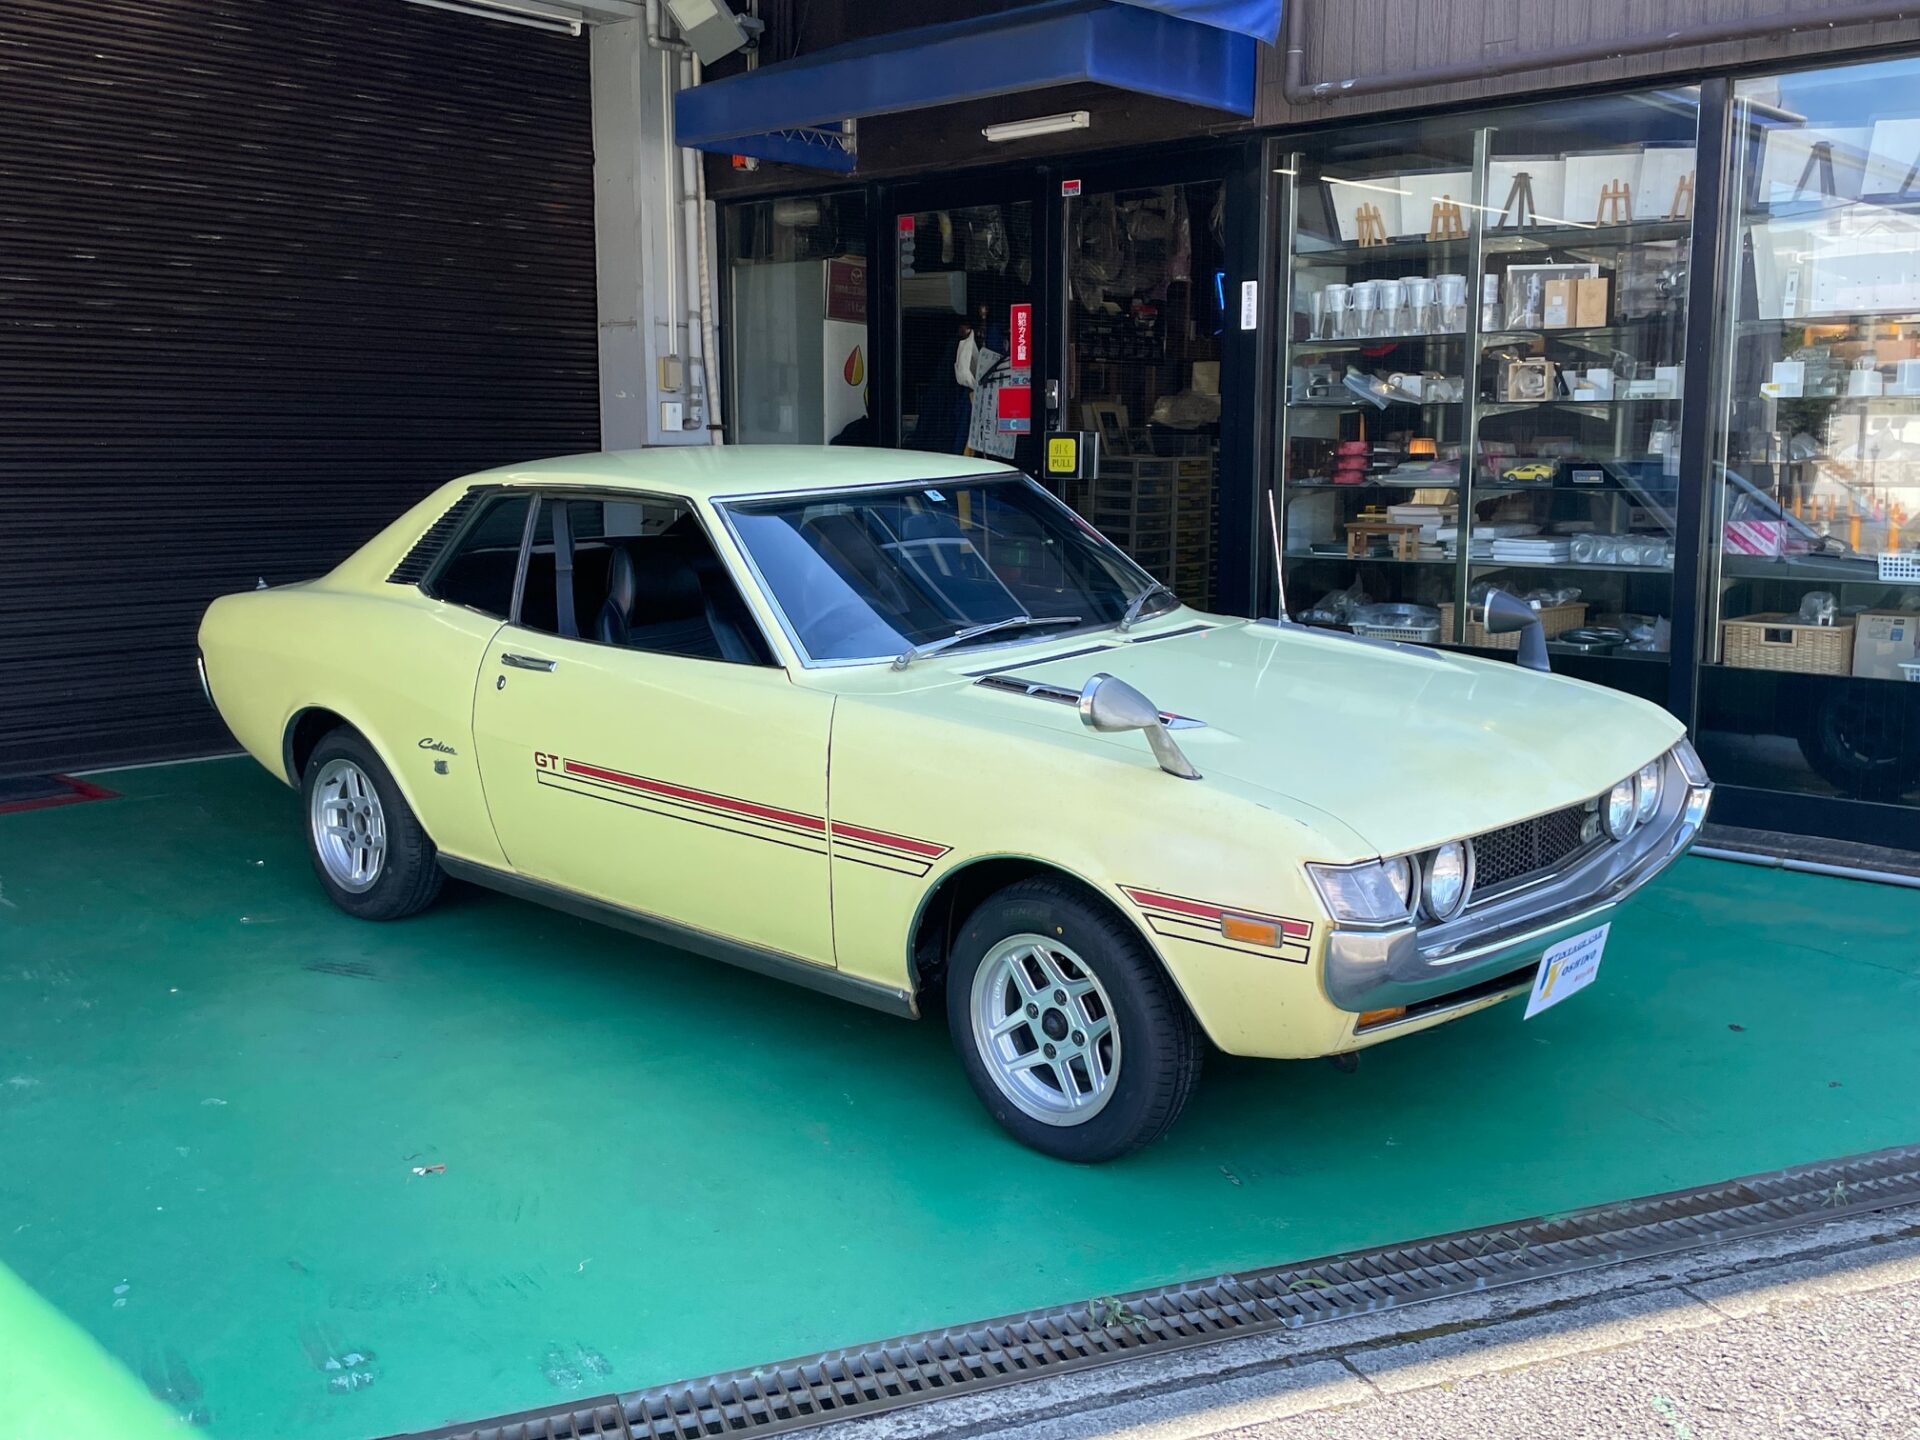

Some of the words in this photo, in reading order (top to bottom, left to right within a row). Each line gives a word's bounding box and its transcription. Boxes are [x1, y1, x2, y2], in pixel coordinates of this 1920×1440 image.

[1017, 312, 1027, 360] 防犯カメラ設置
[1054, 443, 1070, 455] 引く
[1052, 458, 1072, 468] PULL
[418, 737, 458, 756] Celica
[534, 751, 559, 770] GT
